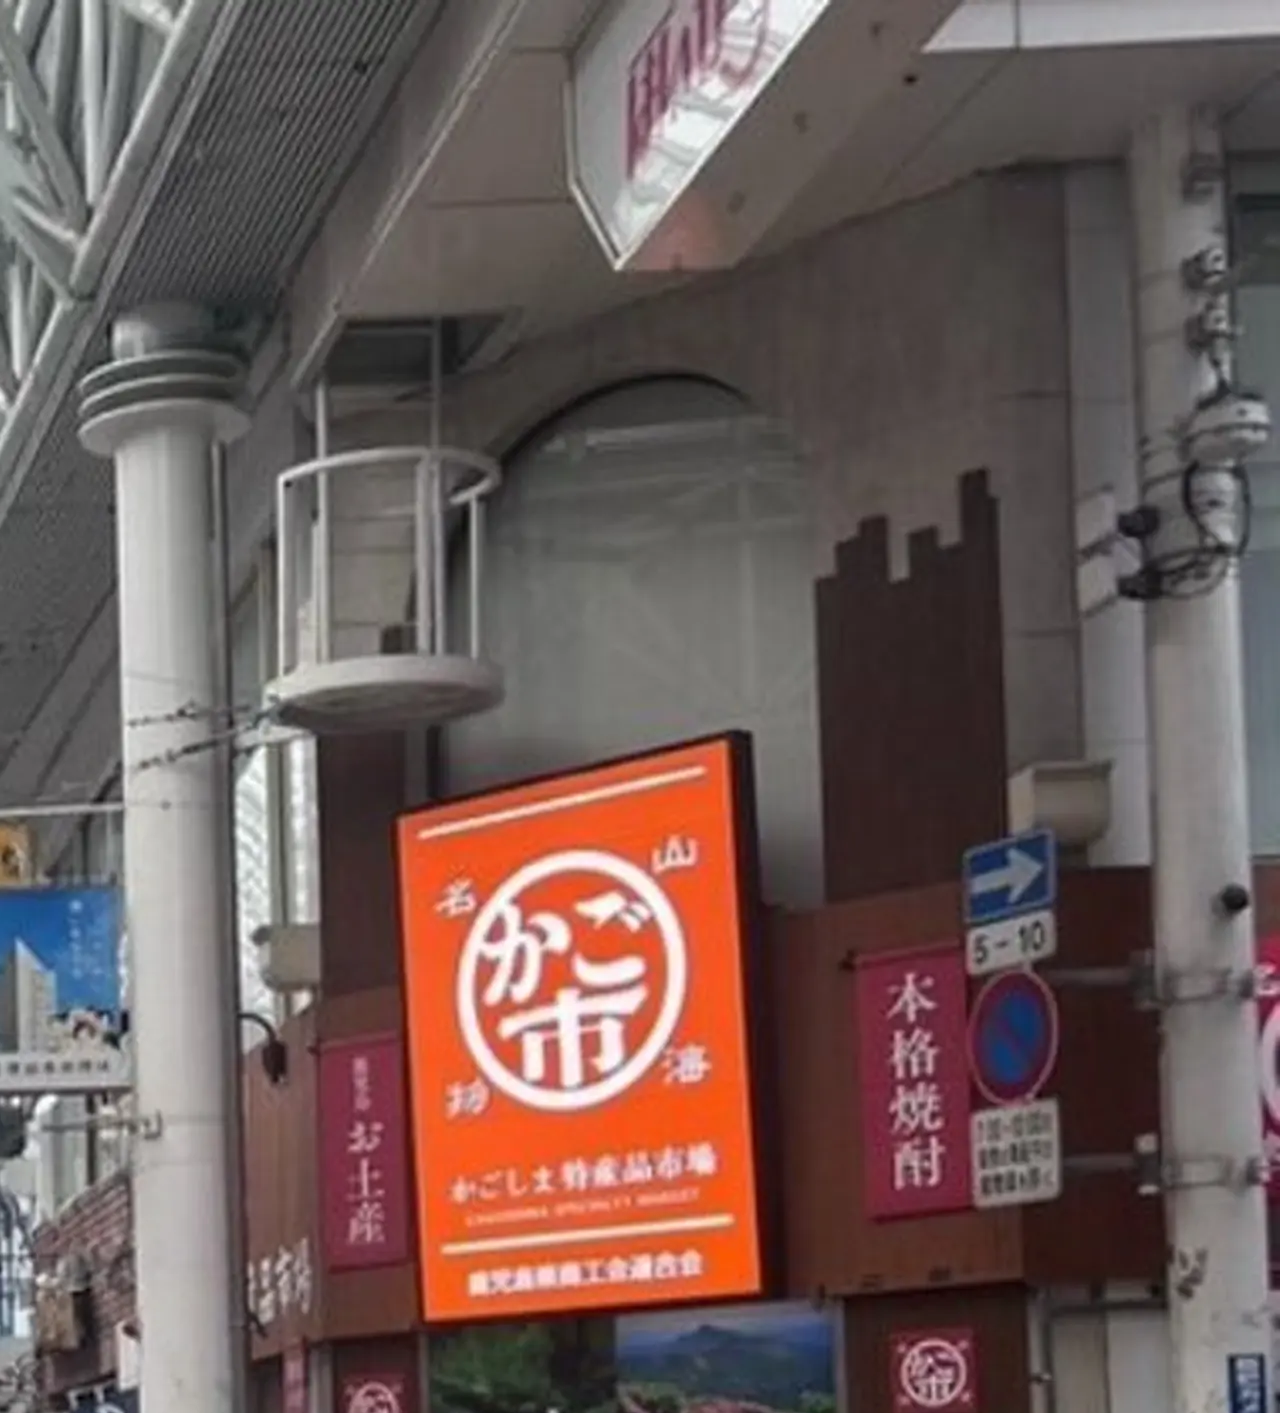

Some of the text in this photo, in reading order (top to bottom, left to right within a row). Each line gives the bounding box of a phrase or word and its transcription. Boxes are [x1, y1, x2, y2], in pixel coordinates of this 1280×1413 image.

[651, 834, 698, 873] 山
[972, 919, 1048, 966] 5-10
[886, 970, 947, 1192] 本格焼酎
[346, 1121, 387, 1244] お土産
